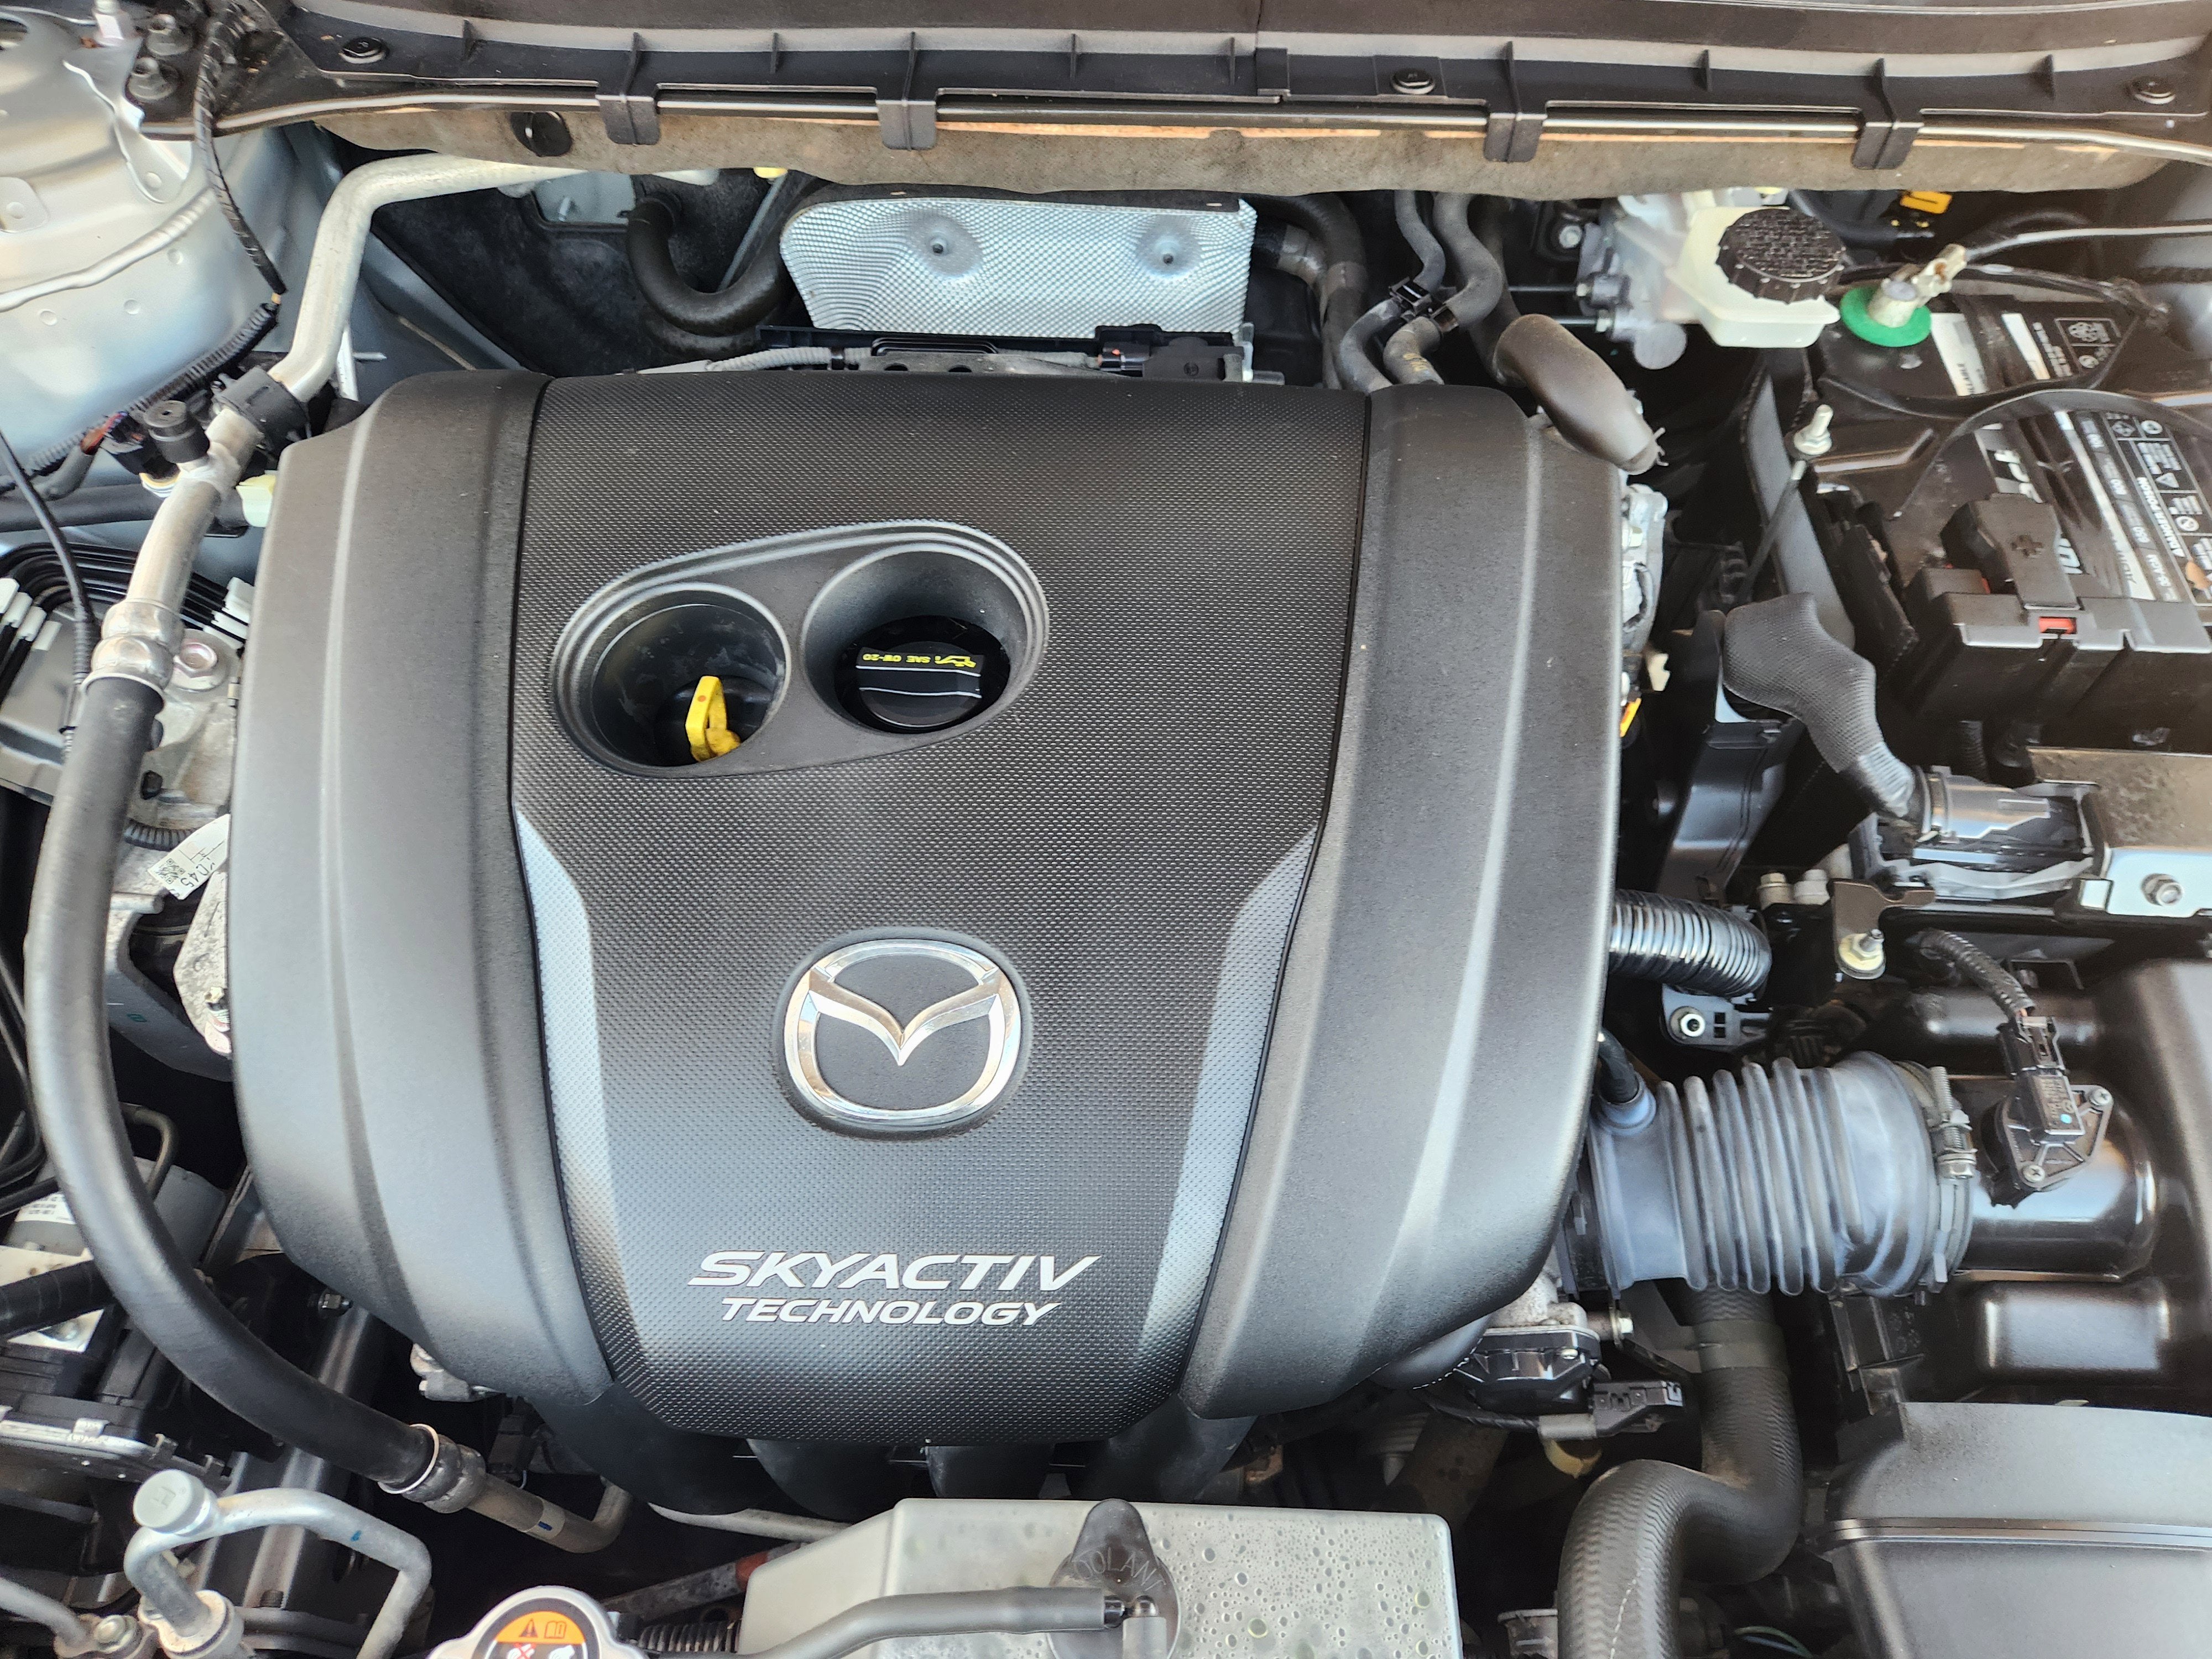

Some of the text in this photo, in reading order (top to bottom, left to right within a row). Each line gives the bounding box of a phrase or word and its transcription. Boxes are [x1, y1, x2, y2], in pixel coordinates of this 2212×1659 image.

[906, 655, 931, 664] SAE
[687, 1250, 1101, 1291] SKYACTIV
[722, 1297, 1061, 1326] TECHNOLOGY
[1073, 1546, 1166, 1592] OOLANT
